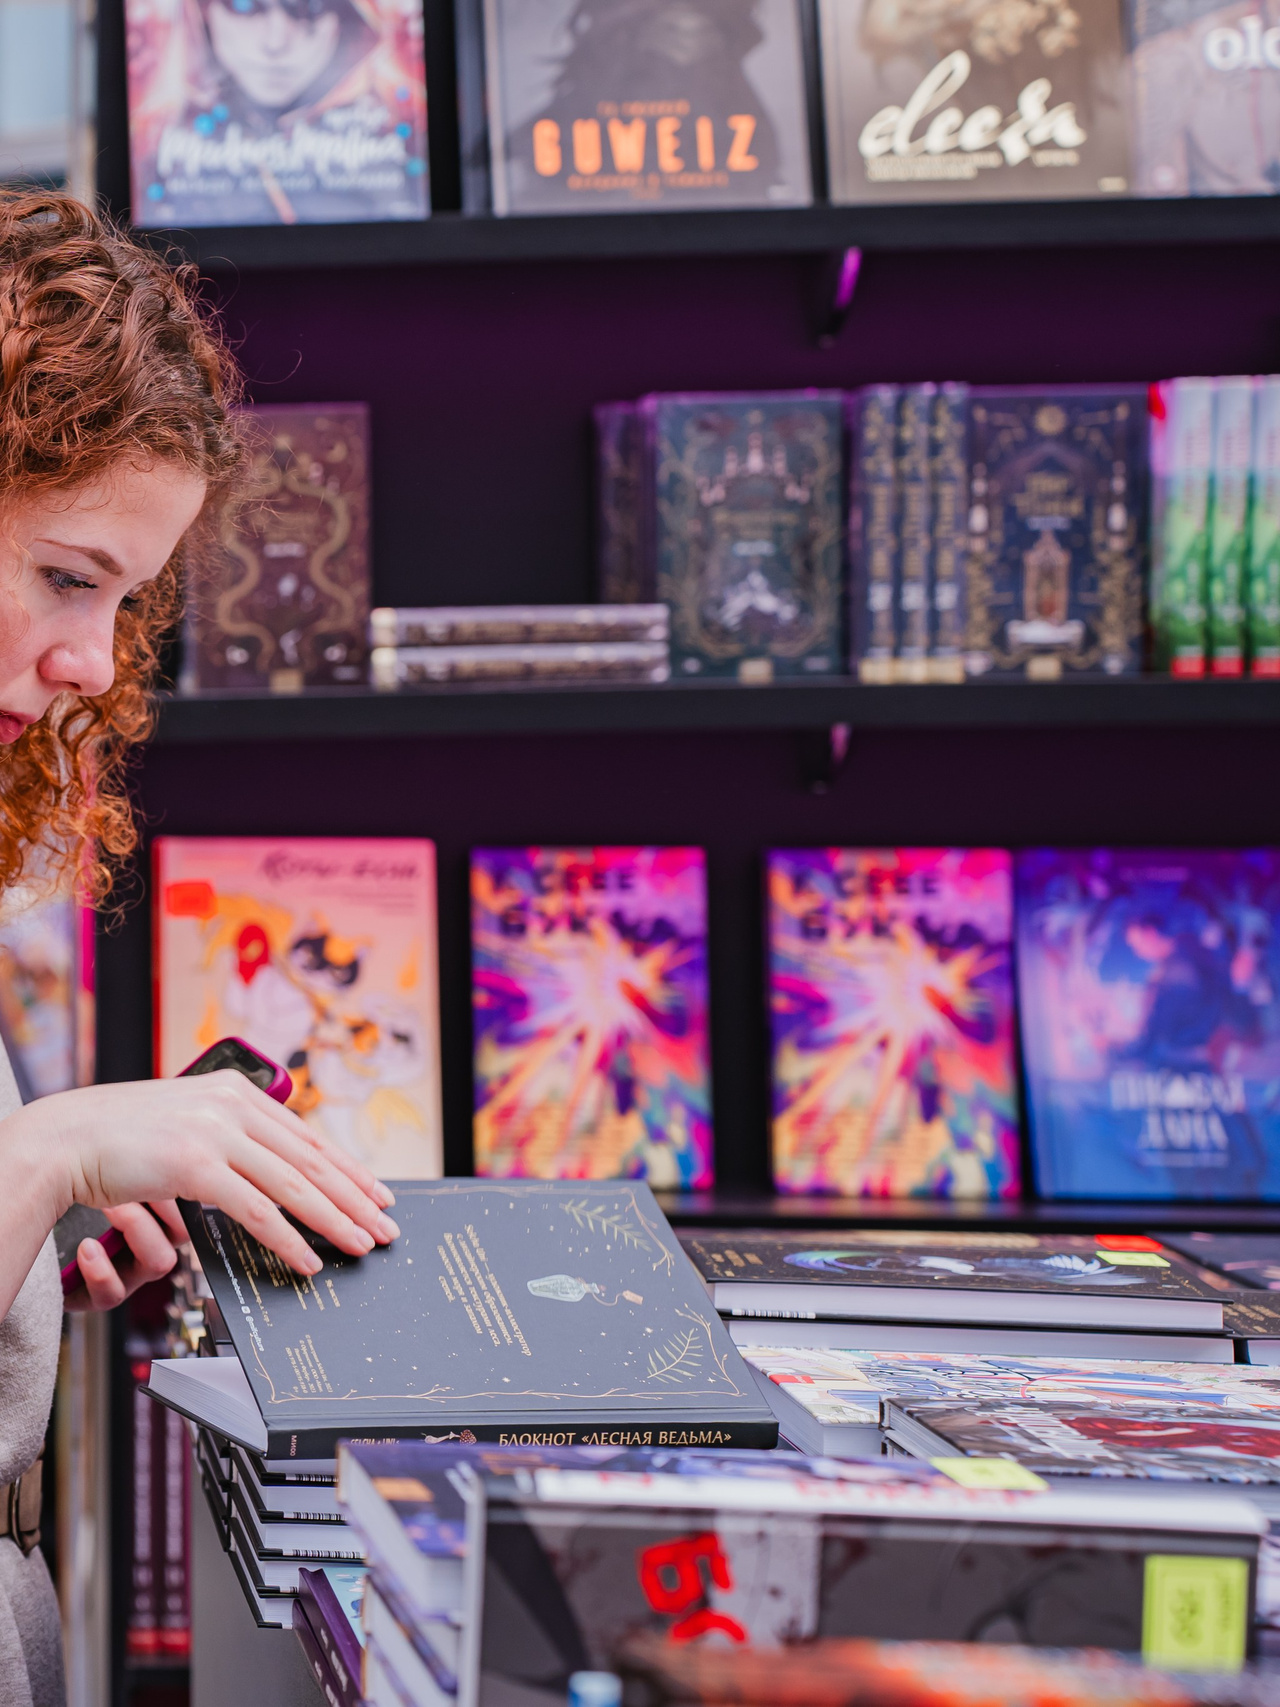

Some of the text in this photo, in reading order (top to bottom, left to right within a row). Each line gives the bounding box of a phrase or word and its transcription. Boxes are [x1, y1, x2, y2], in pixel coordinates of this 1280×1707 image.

[464, 1304, 482, 1333] запахом
[469, 1287, 492, 1326] текстурами
[484, 1291, 513, 1345] образованием.
[499, 1430, 732, 1447] БЛОКНОТ «ЛЕСНАЯ ВЕДЬМА»
